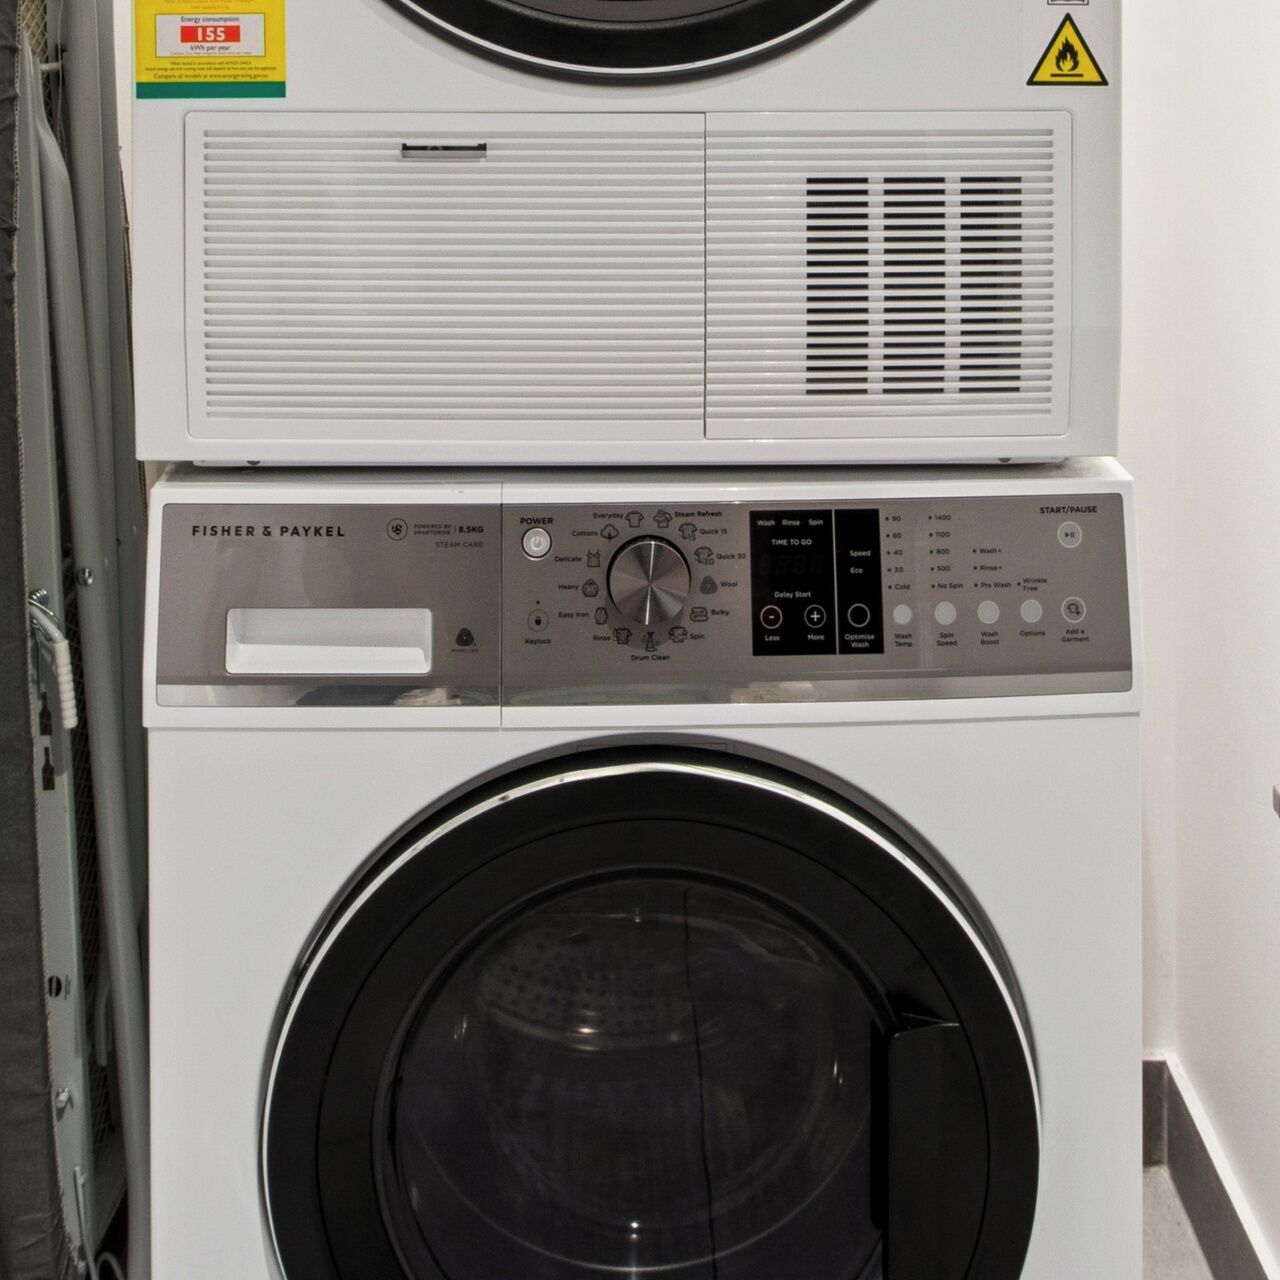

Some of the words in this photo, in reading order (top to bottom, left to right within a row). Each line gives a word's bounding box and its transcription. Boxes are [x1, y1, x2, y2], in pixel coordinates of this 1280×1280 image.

[181, 16, 200, 24] Energy
[197, 27, 226, 41] 155
[1039, 506, 1097, 514] START/PAUSE
[192, 526, 255, 537] FISHER
[262, 526, 272, 537] &
[280, 526, 345, 537] PAYKEL
[458, 526, 484, 534] 8.5KG
[800, 538, 813, 546] GO
[844, 633, 875, 641] Optimise
[894, 640, 913, 648] Temp
